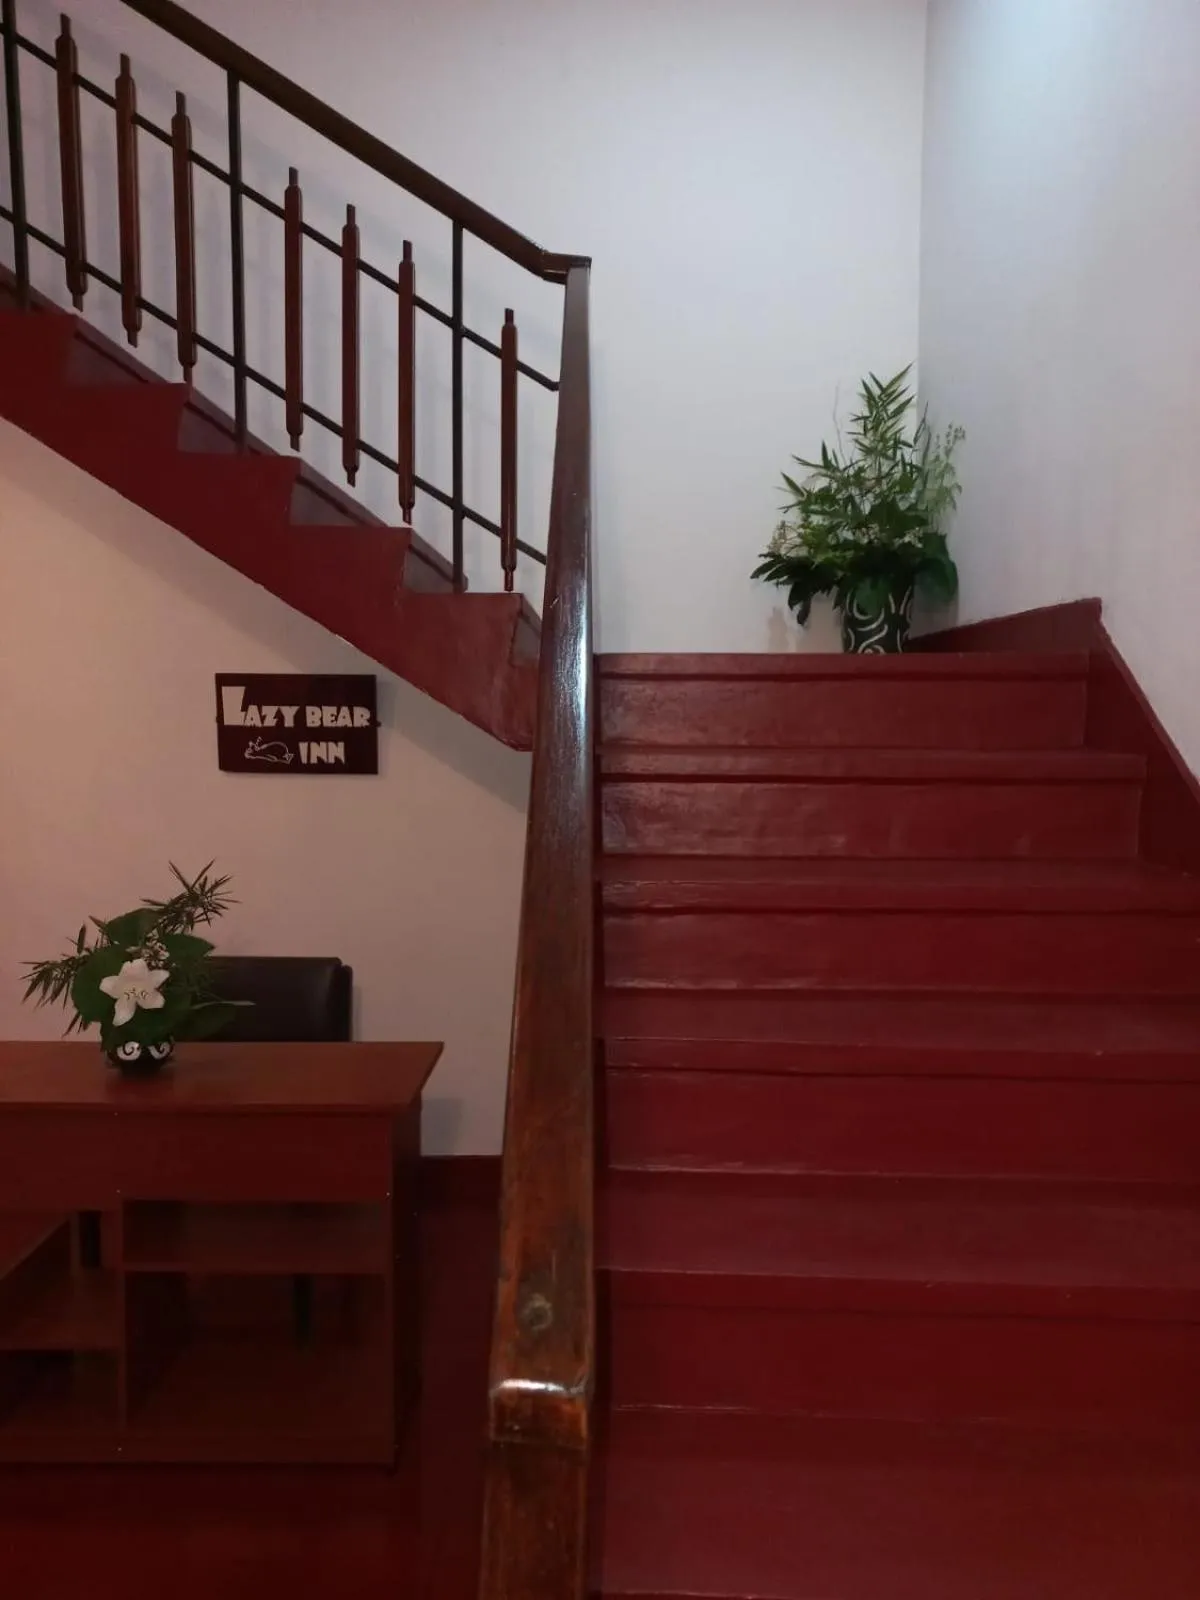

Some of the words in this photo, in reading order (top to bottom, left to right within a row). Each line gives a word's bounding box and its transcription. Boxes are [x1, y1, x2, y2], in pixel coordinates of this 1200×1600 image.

[222, 686, 299, 727] LAZY
[305, 706, 370, 727] BEAR
[299, 742, 345, 764] INN
